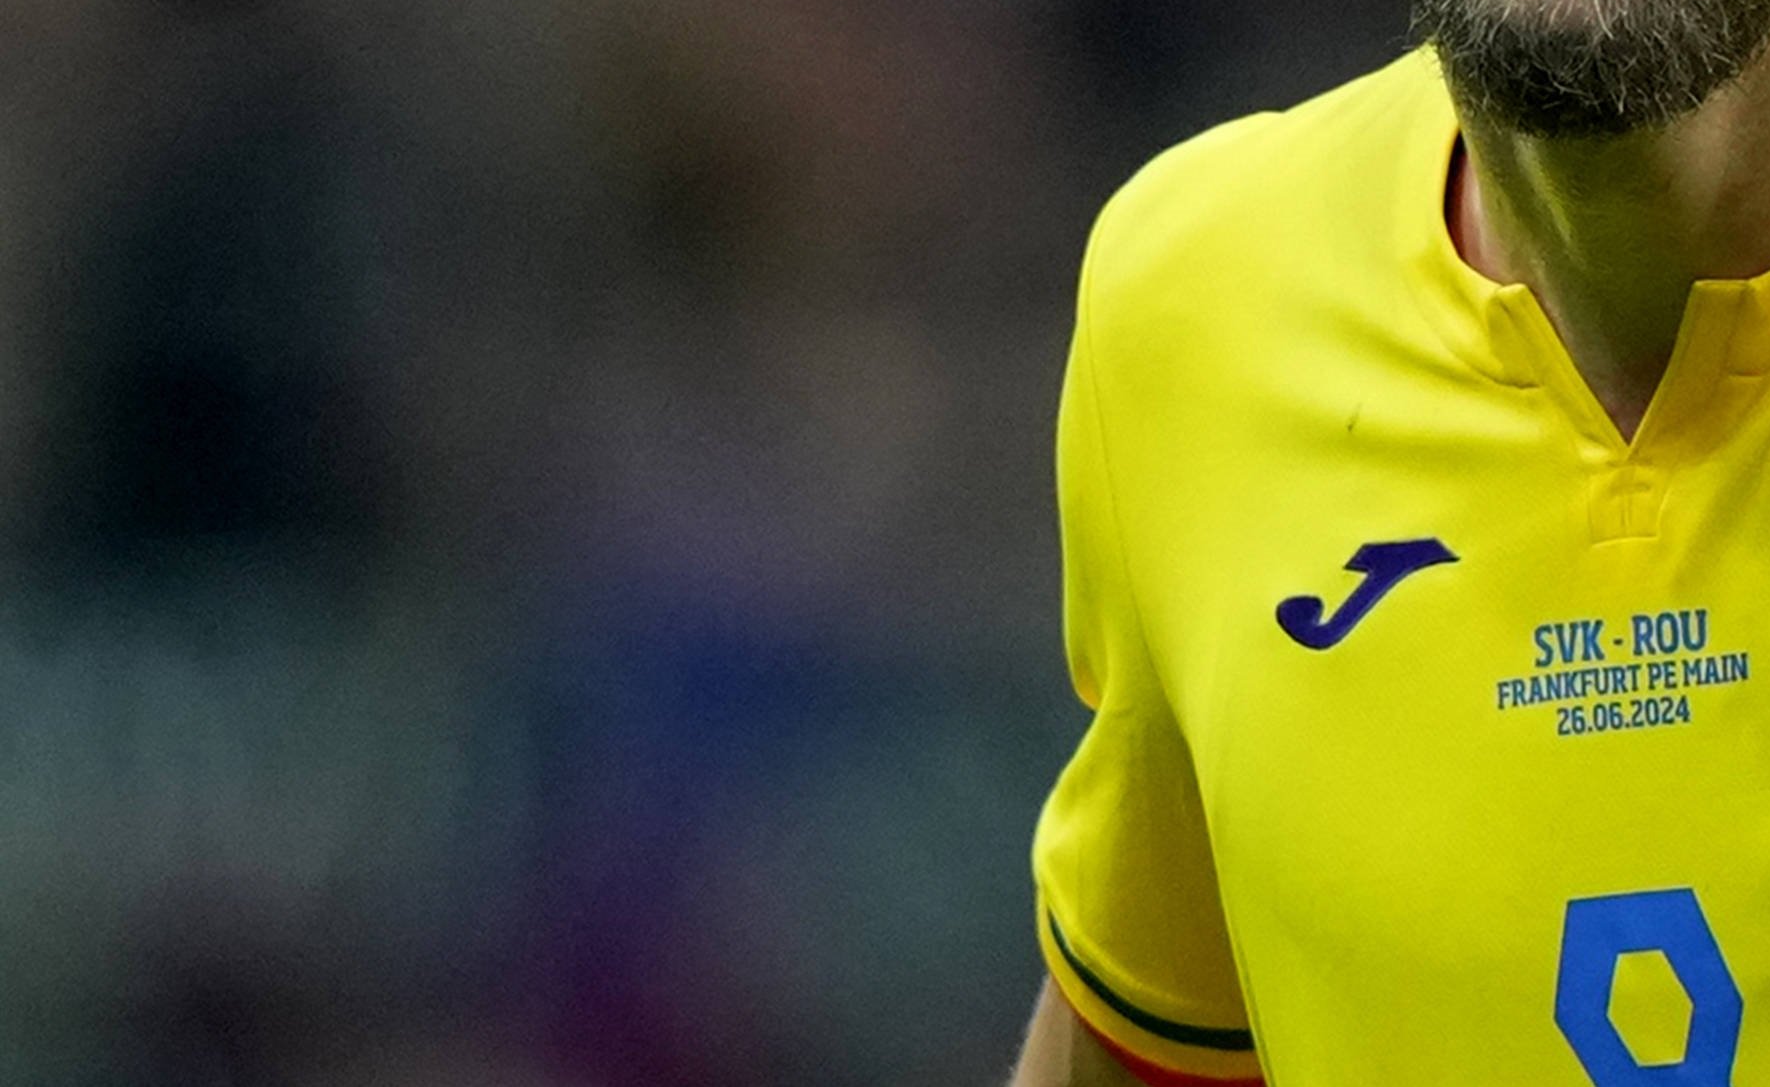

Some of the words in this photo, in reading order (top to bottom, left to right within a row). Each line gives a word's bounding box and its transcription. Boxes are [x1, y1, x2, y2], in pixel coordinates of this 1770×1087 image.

[1534, 620, 1605, 667] SVK
[1632, 609, 1708, 656] ROU
[1497, 664, 1641, 710] FRANKFURT
[1647, 661, 1677, 691] PE
[1682, 653, 1749, 691] MAIN
[1557, 695, 1691, 736] 26.06.2024
